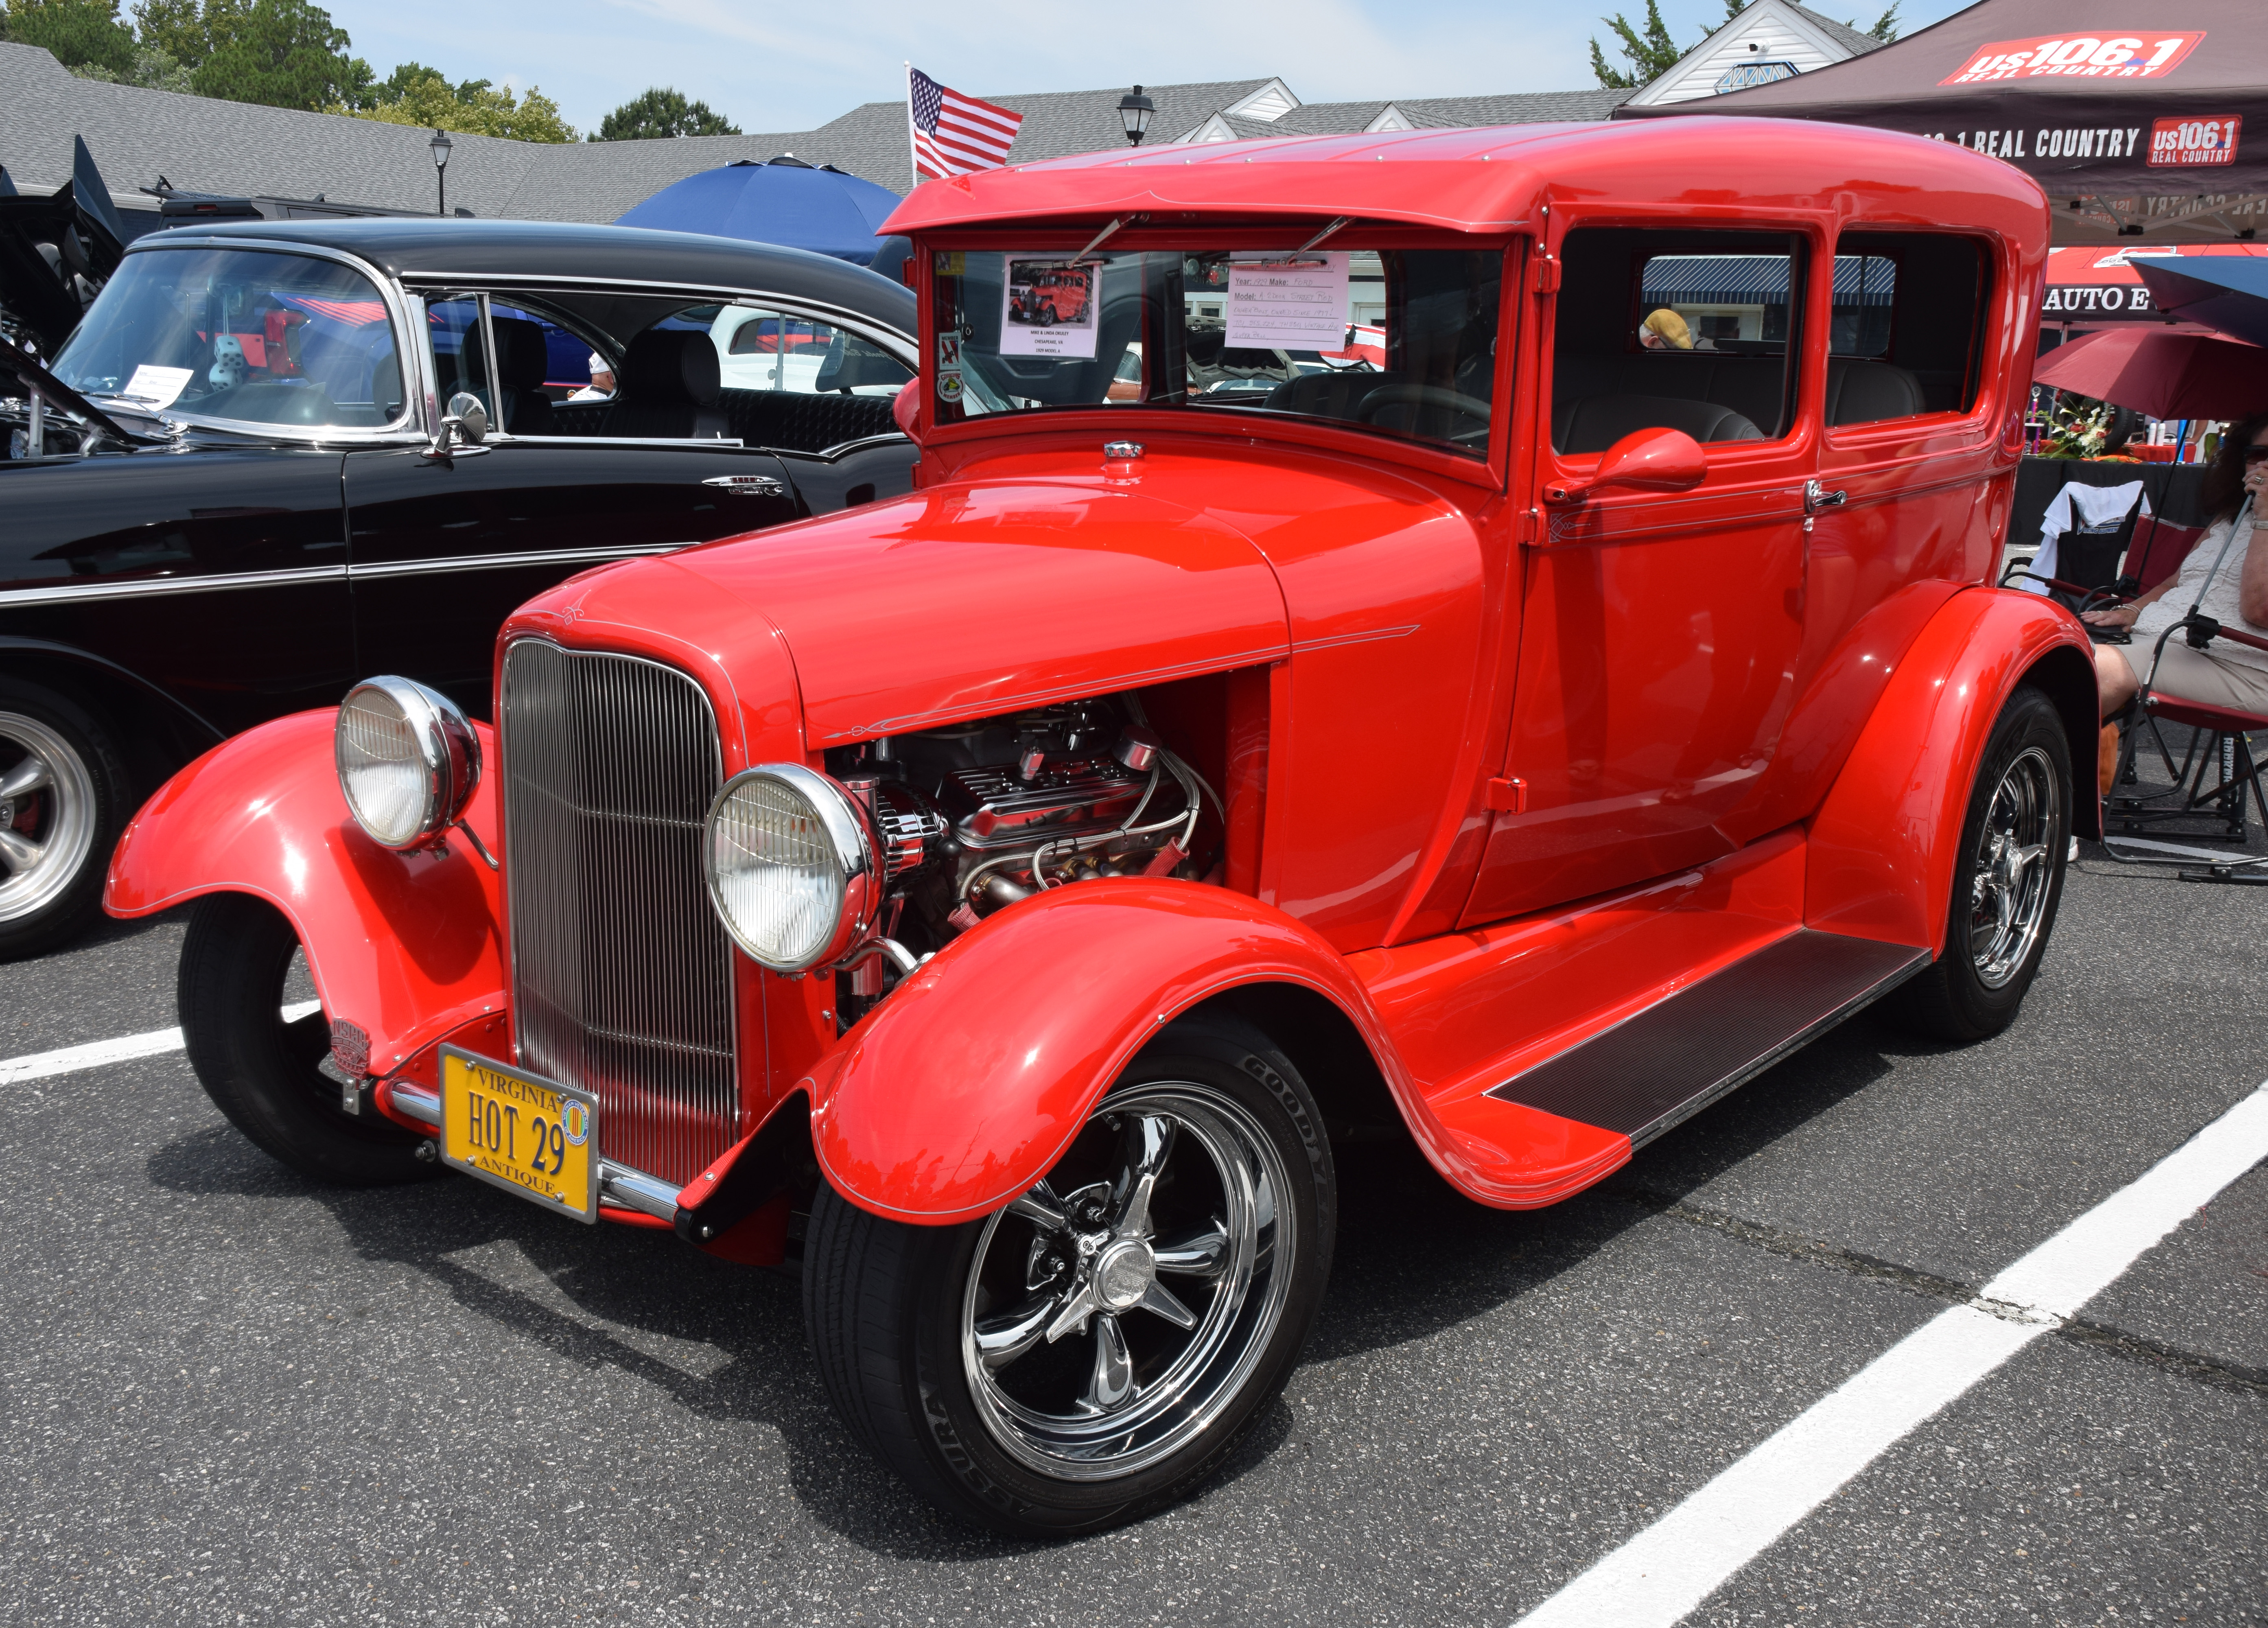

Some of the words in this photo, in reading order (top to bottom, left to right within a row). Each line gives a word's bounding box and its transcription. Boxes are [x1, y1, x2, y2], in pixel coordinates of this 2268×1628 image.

[1954, 68, 2021, 83] REAL
[2030, 65, 2159, 77] COUNTRY
[1973, 130, 2025, 158] REAL
[2035, 128, 2140, 158] COUNTRY
[2152, 150, 2177, 163] REAL
[2182, 149, 2231, 162] COUNTRY
[1294, 278, 1313, 286] FORD
[2042, 287, 2124, 311] AUTO
[2128, 288, 2151, 310] E
[478, 1068, 558, 1113] VIRGINIA
[563, 1101, 574, 1120] VIETNAM
[574, 1101, 588, 1129] VETERANS
[468, 1091, 520, 1160] HOT
[531, 1116, 565, 1175] 29
[480, 1156, 556, 1195] ANTIQUE
[1244, 1055, 1327, 1271] GOODYEAR
